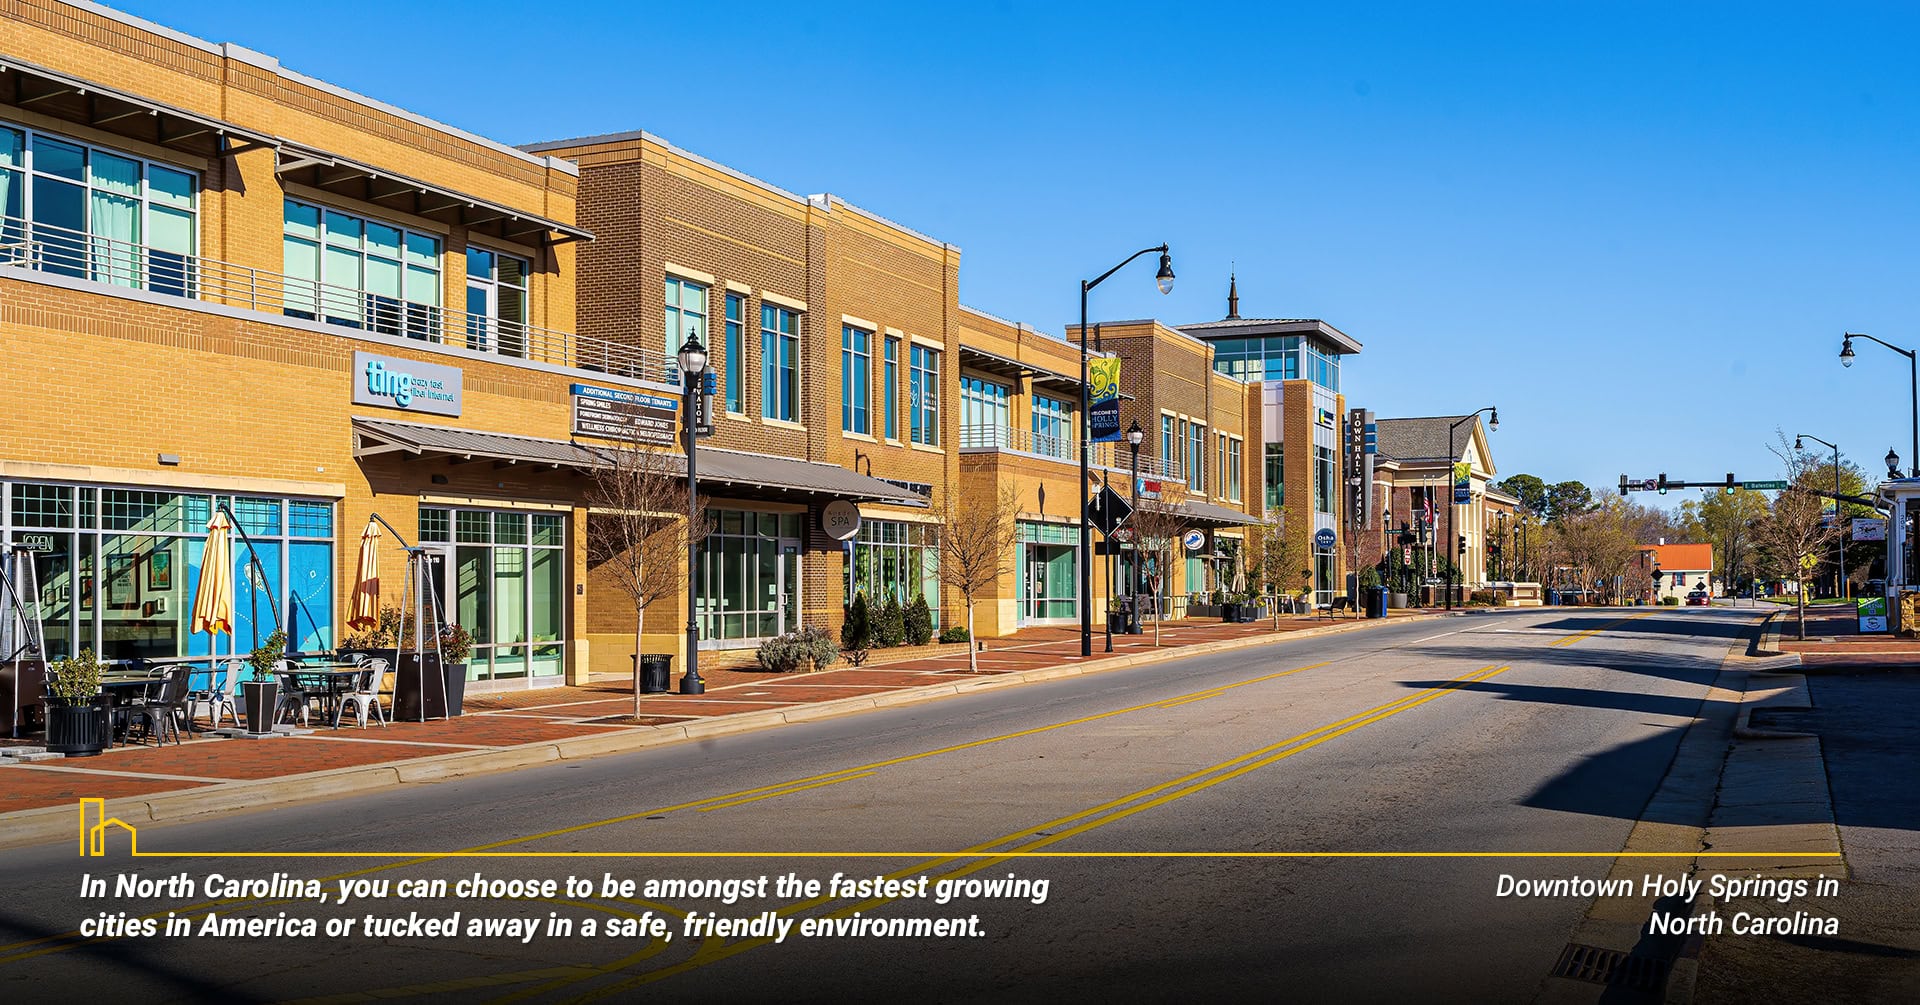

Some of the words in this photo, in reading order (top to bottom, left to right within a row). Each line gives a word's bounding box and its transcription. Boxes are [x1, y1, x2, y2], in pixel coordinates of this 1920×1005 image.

[365, 360, 413, 407] ting
[582, 387, 613, 398] ADDITIONAL
[614, 392, 634, 402] SECOND
[634, 395, 651, 404] FLOOR
[651, 398, 673, 408] TENANTS
[1354, 412, 1362, 442] TOWN
[831, 516, 849, 526] SPA
[26, 535, 53, 550] OPEN
